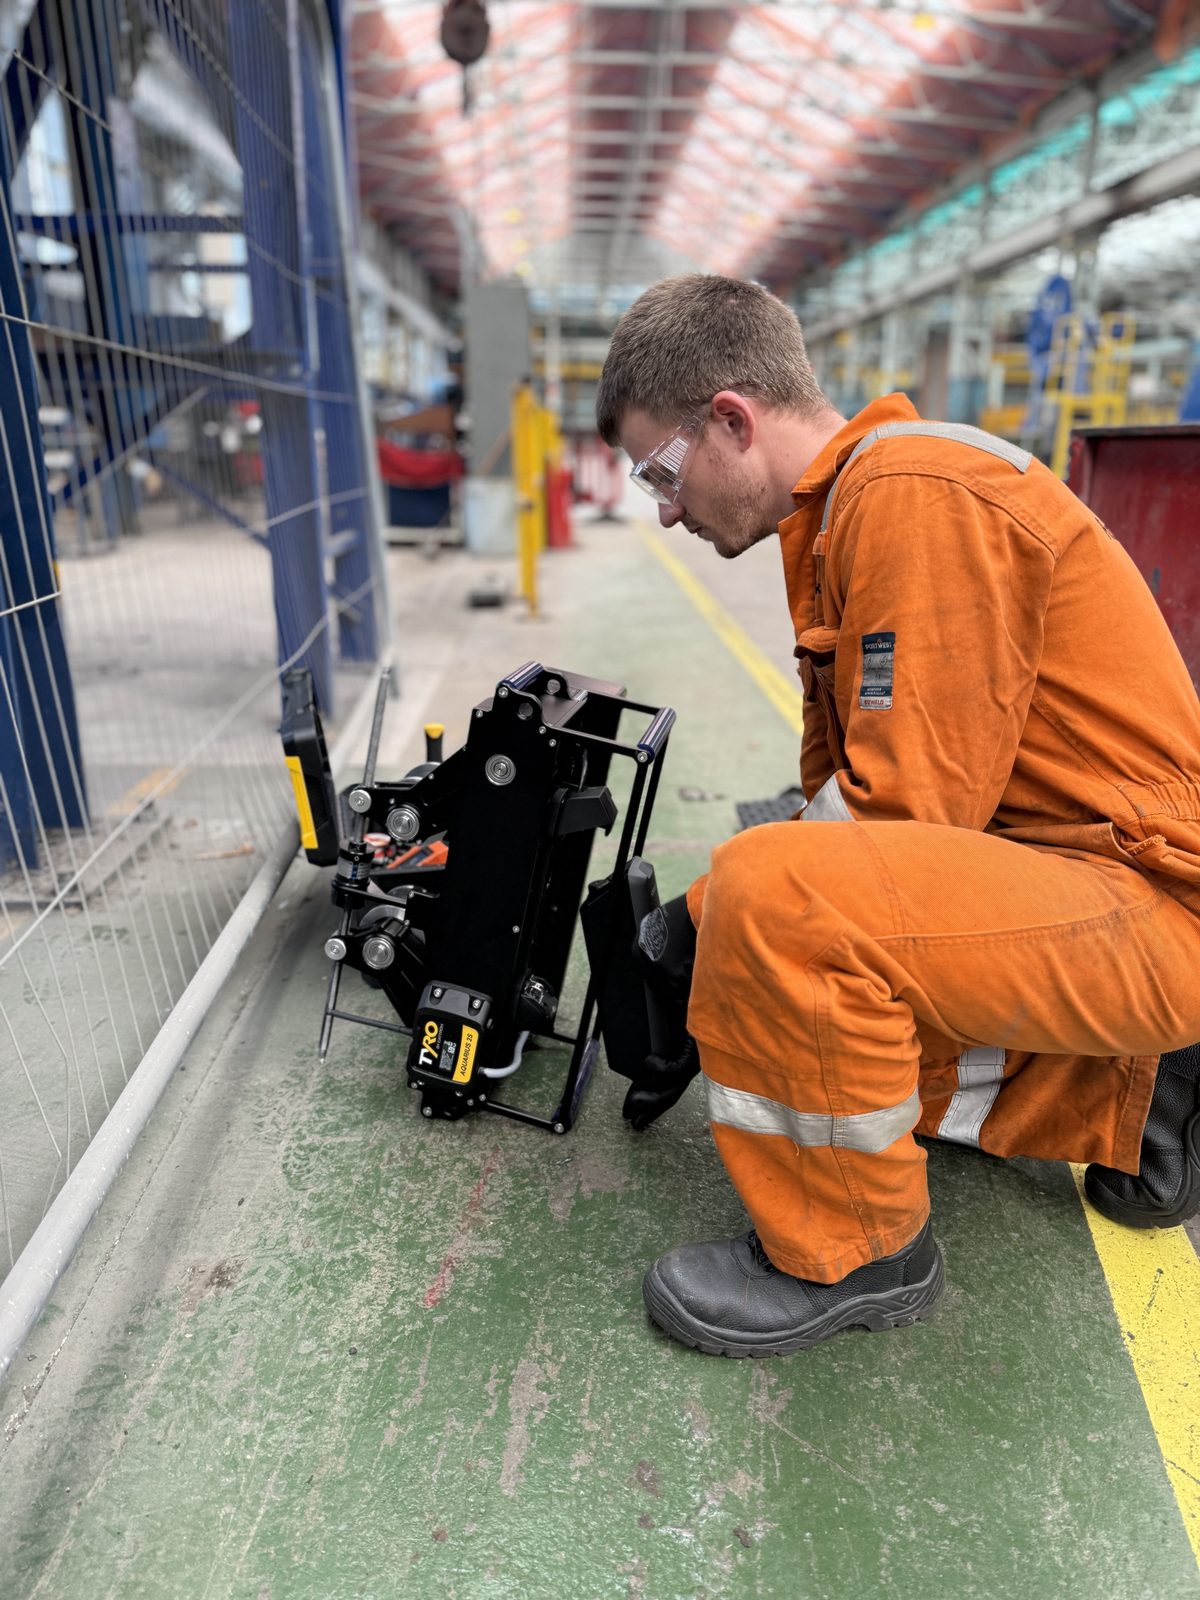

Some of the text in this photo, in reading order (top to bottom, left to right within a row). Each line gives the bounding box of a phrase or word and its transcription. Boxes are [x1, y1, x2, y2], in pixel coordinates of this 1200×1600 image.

[865, 642, 892, 650] PORTWEST
[418, 1020, 438, 1065] TYRO
[460, 1042, 472, 1076] AQUARIUS
